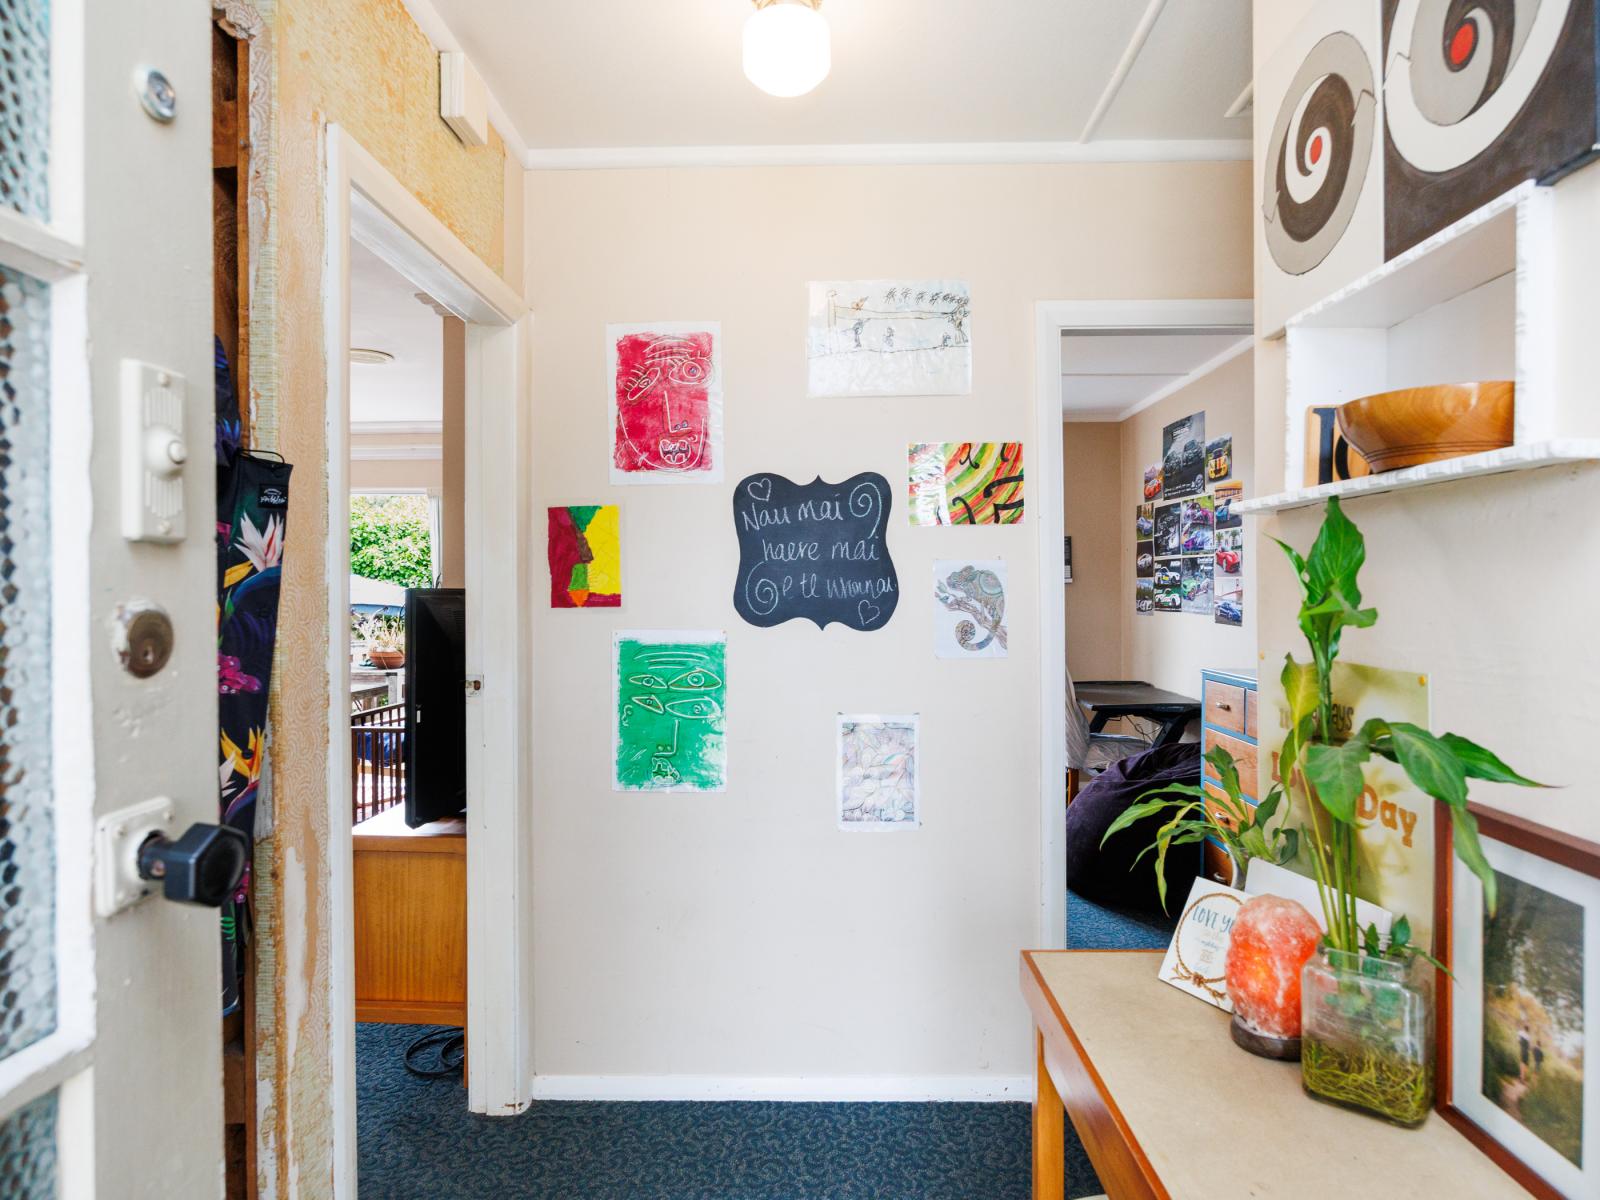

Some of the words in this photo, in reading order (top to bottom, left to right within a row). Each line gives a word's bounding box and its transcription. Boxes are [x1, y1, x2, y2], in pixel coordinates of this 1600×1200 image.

[742, 502, 791, 531] Nau
[762, 538, 821, 562] haere
[831, 535, 880, 561] mai
[800, 572, 821, 599] te
[1357, 783, 1417, 848] Day
